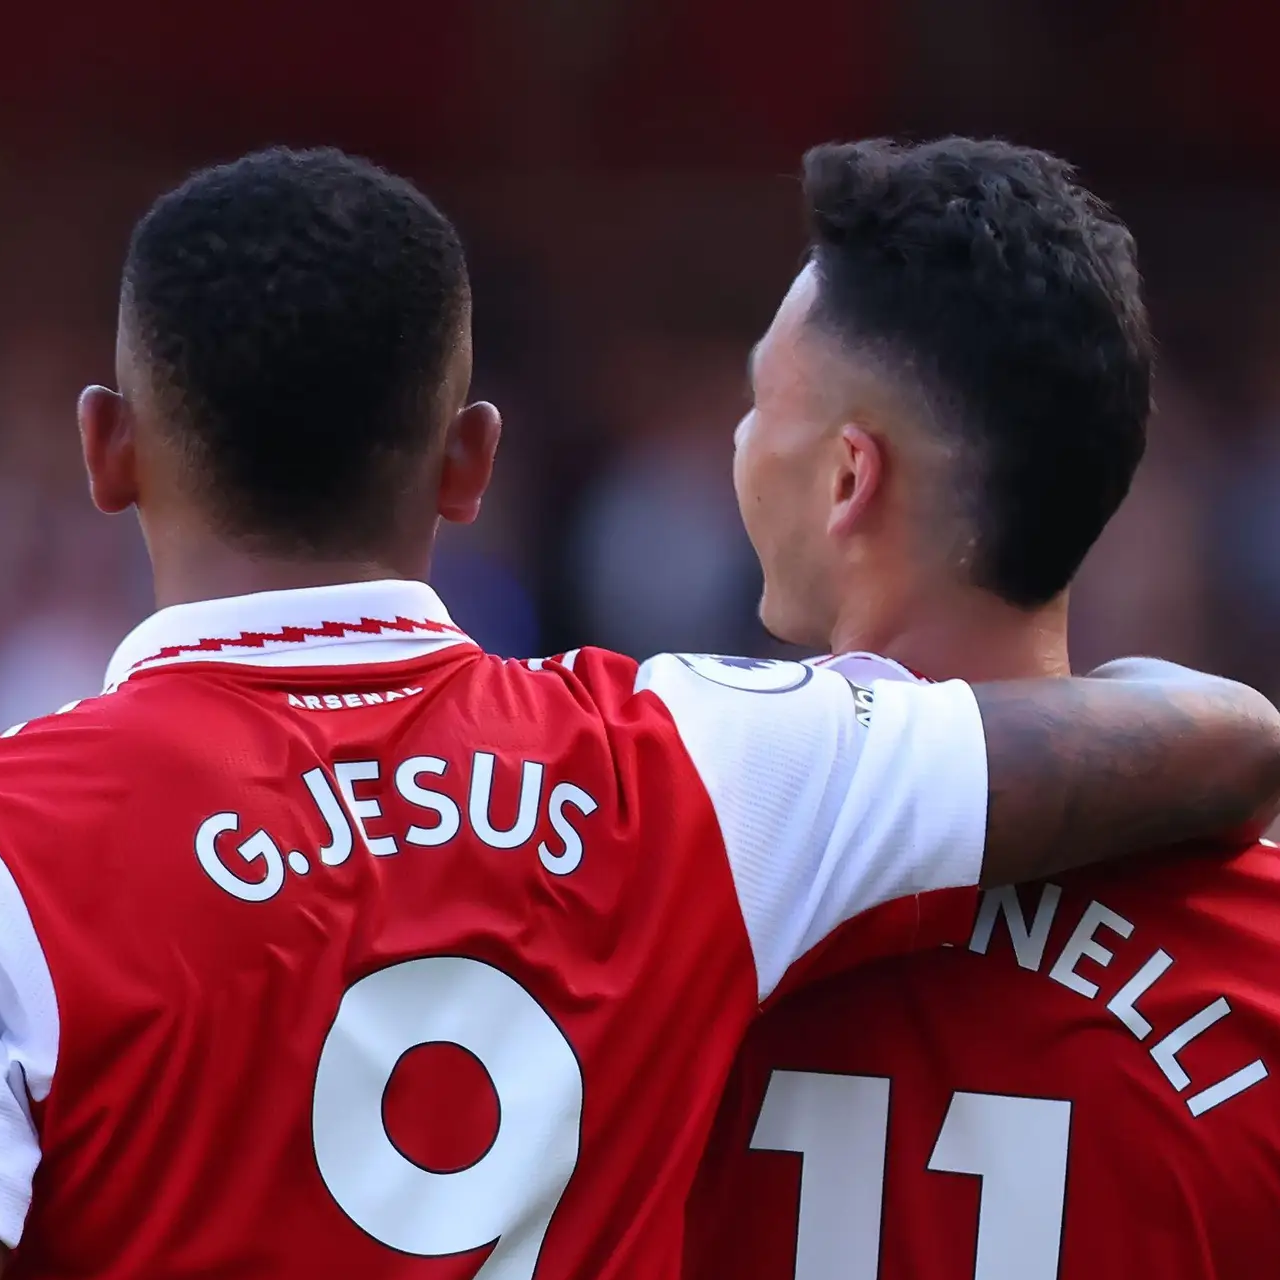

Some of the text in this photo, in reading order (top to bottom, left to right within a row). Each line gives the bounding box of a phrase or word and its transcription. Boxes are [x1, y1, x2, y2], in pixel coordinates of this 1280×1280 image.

[287, 686, 424, 710] ARSENAL
[194, 750, 599, 903] G.JESUS
[942, 882, 1270, 1119] NELLI
